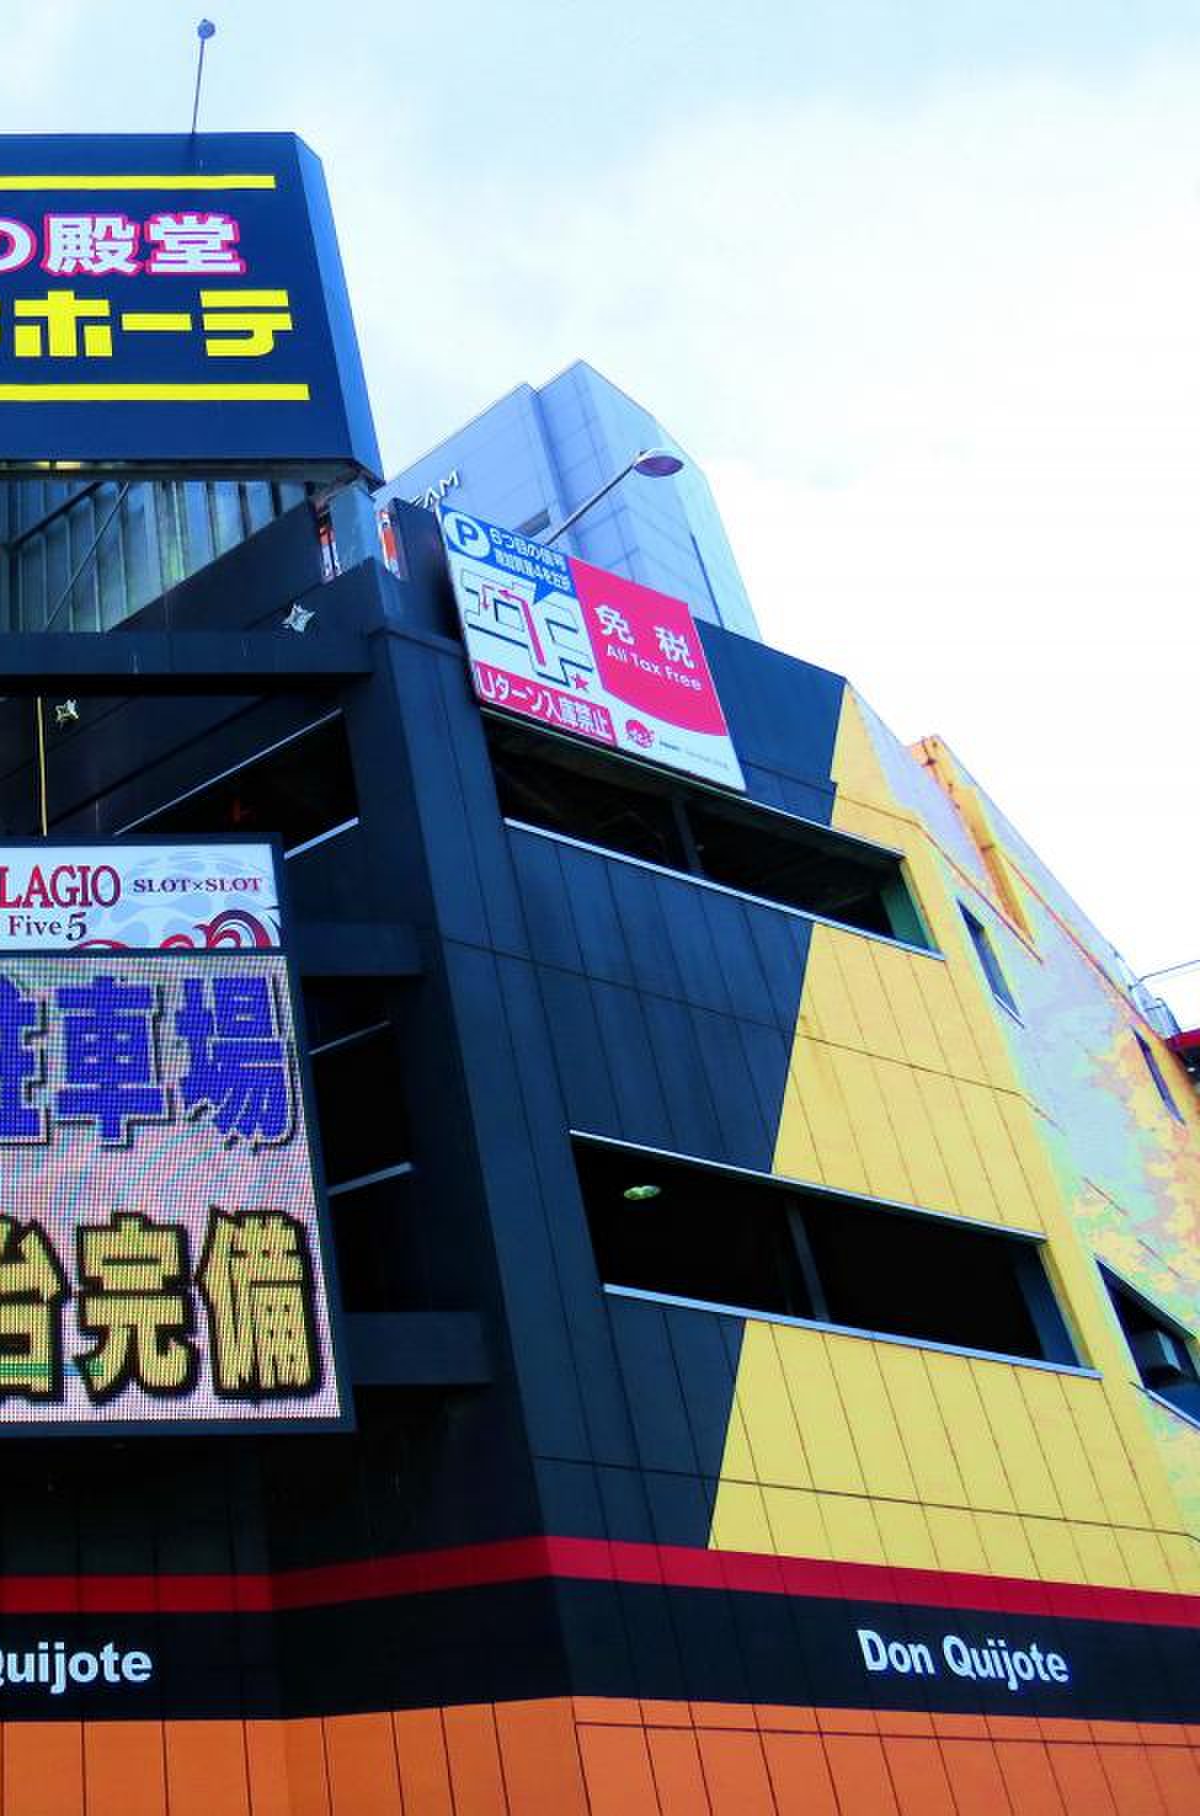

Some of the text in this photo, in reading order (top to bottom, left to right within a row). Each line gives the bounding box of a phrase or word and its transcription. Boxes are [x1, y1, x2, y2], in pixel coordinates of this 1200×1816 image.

[629, 651, 661, 675] Tax
[8, 915, 62, 936] Five
[65, 911, 88, 941] 5
[856, 1629, 1069, 1690] Don Quijote
